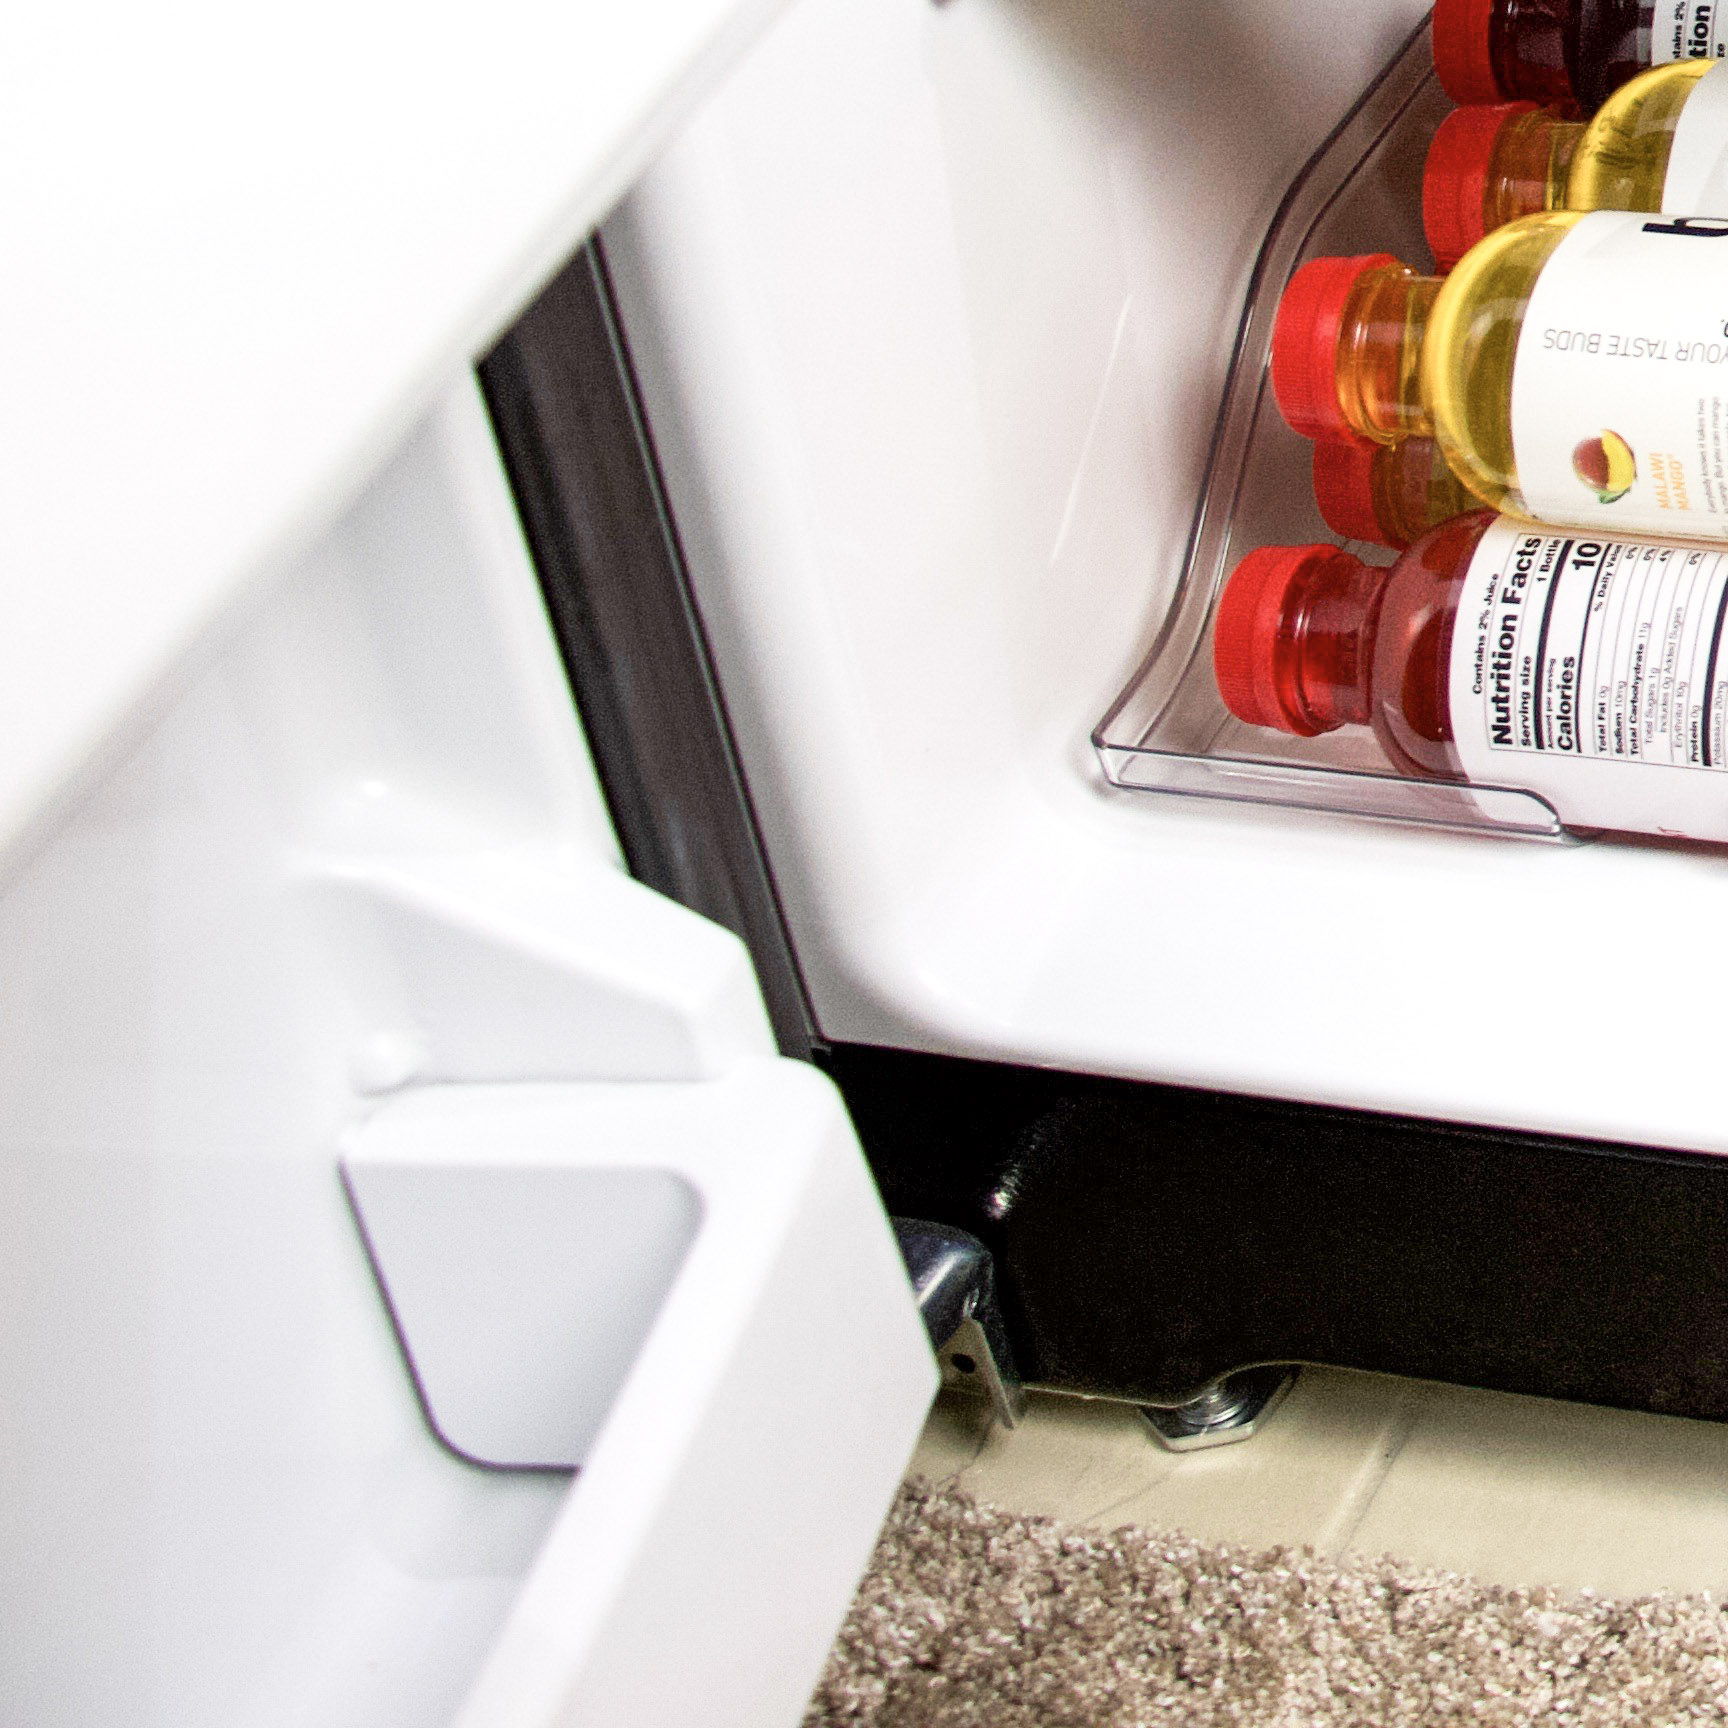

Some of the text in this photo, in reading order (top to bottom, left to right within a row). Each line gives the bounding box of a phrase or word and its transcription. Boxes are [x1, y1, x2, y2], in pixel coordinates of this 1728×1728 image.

[1543, 328, 1601, 354] BUDS
[1605, 335, 1668, 360] TASTE
[1649, 451, 1672, 511] MALAWI
[1538, 539, 1561, 573] Bottle
[1597, 570, 1613, 598] Daily
[1472, 635, 1487, 695] Contains
[1484, 573, 1500, 606] Juice
[1490, 537, 1542, 745] Nutrition Facts
[1556, 542, 1601, 751] Calories 10
[1629, 643, 1644, 722] Carbohydrate
[1520, 655, 1532, 747] Serving size
[1597, 701, 1606, 719] Fat
[1597, 722, 1607, 753] Total
[1630, 725, 1639, 756] Total
